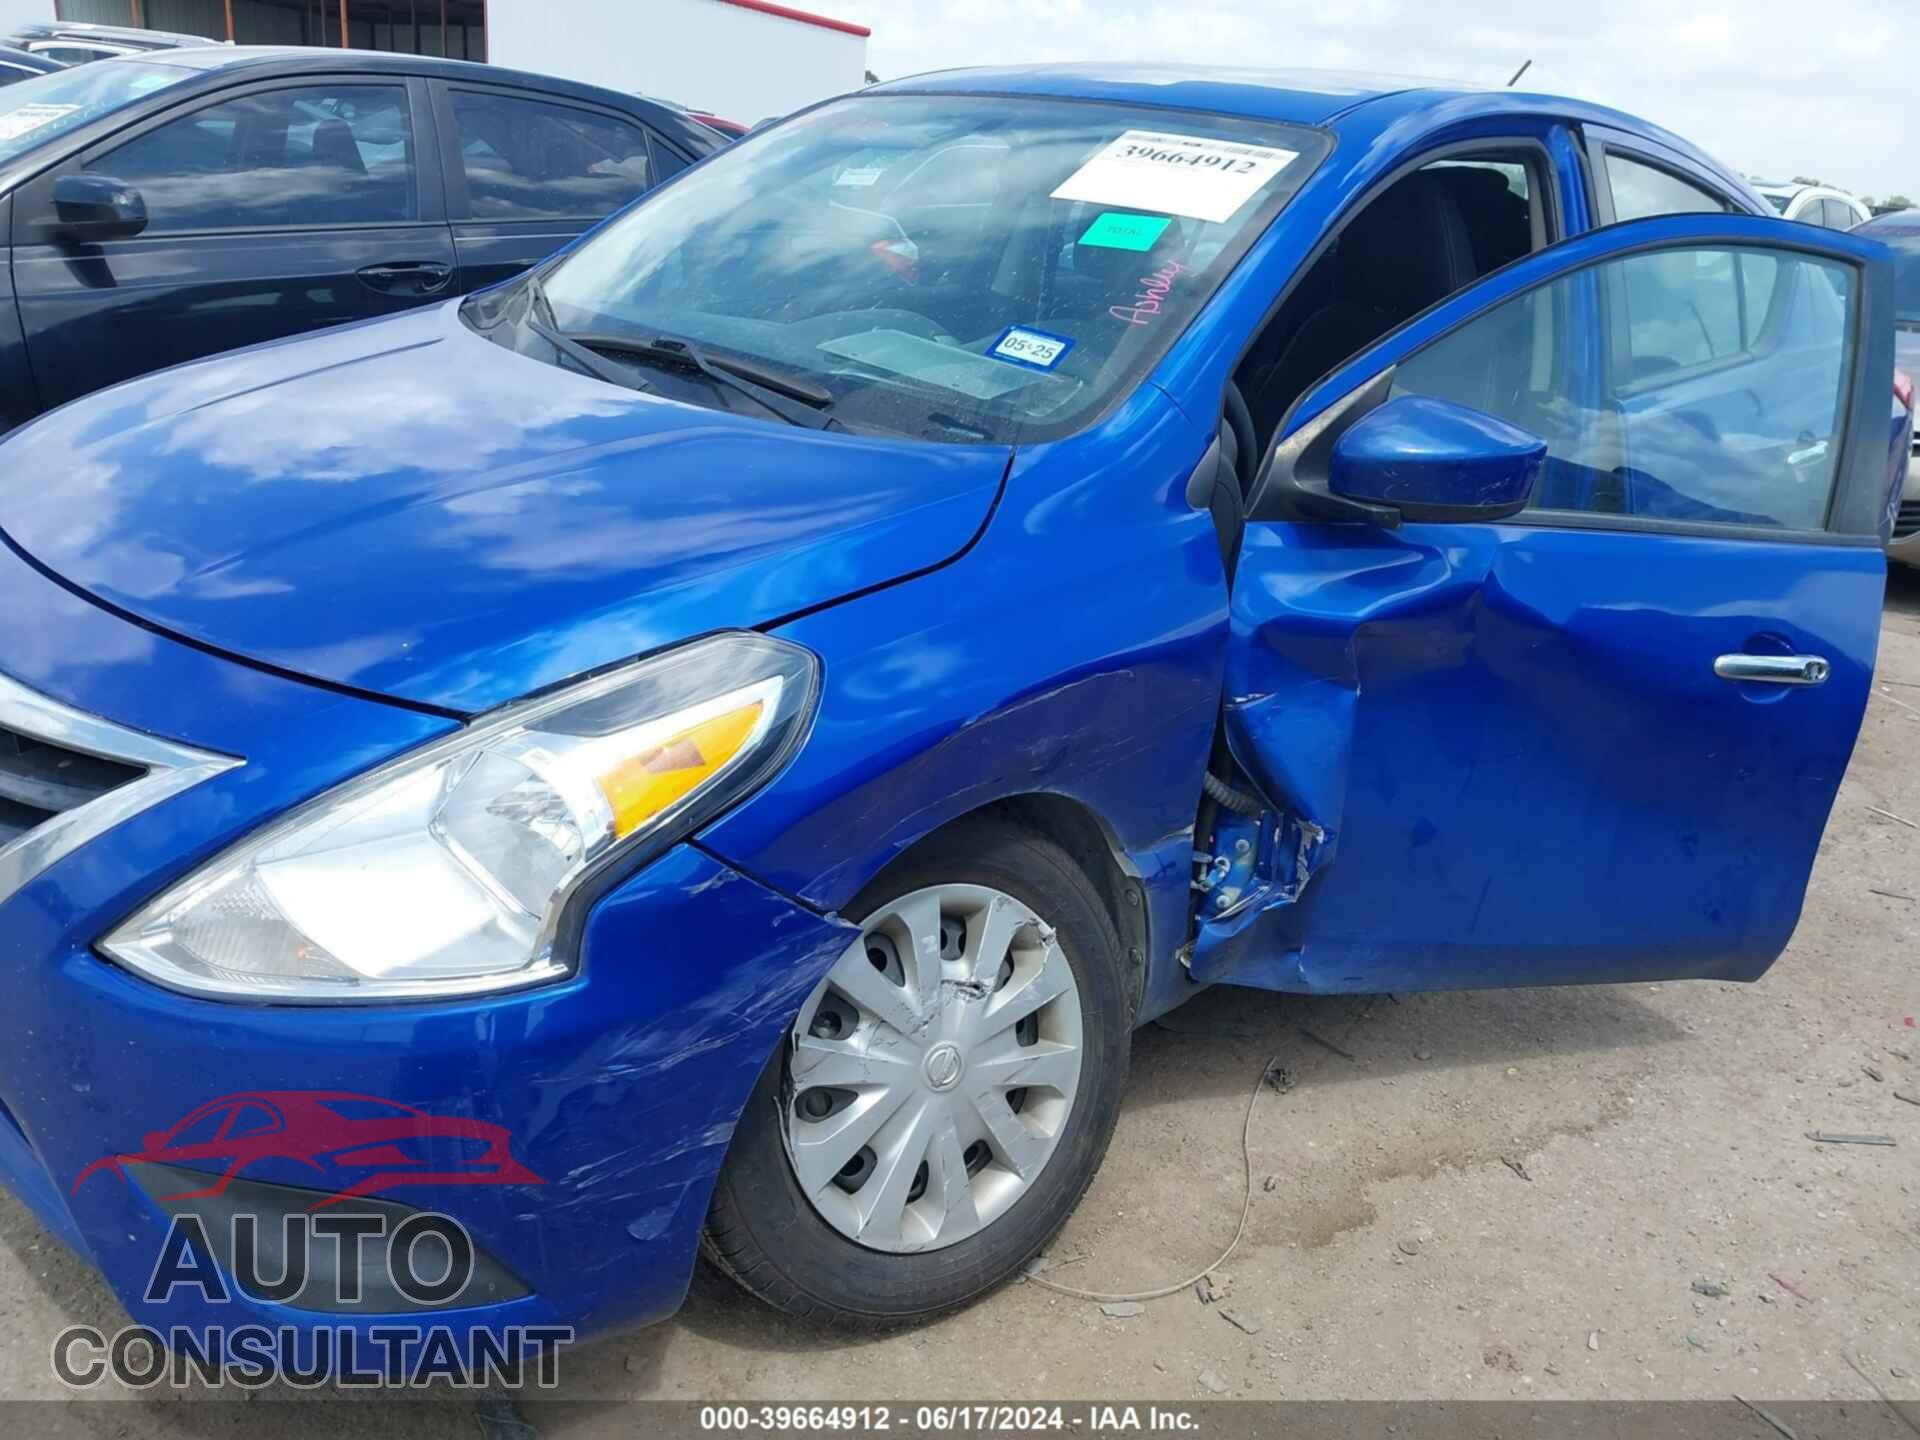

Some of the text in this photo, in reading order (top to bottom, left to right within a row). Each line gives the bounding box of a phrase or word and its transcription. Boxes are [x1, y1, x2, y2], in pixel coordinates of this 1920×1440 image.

[1115, 144, 1257, 174] 39664912
[1003, 337, 1057, 360] 05 25
